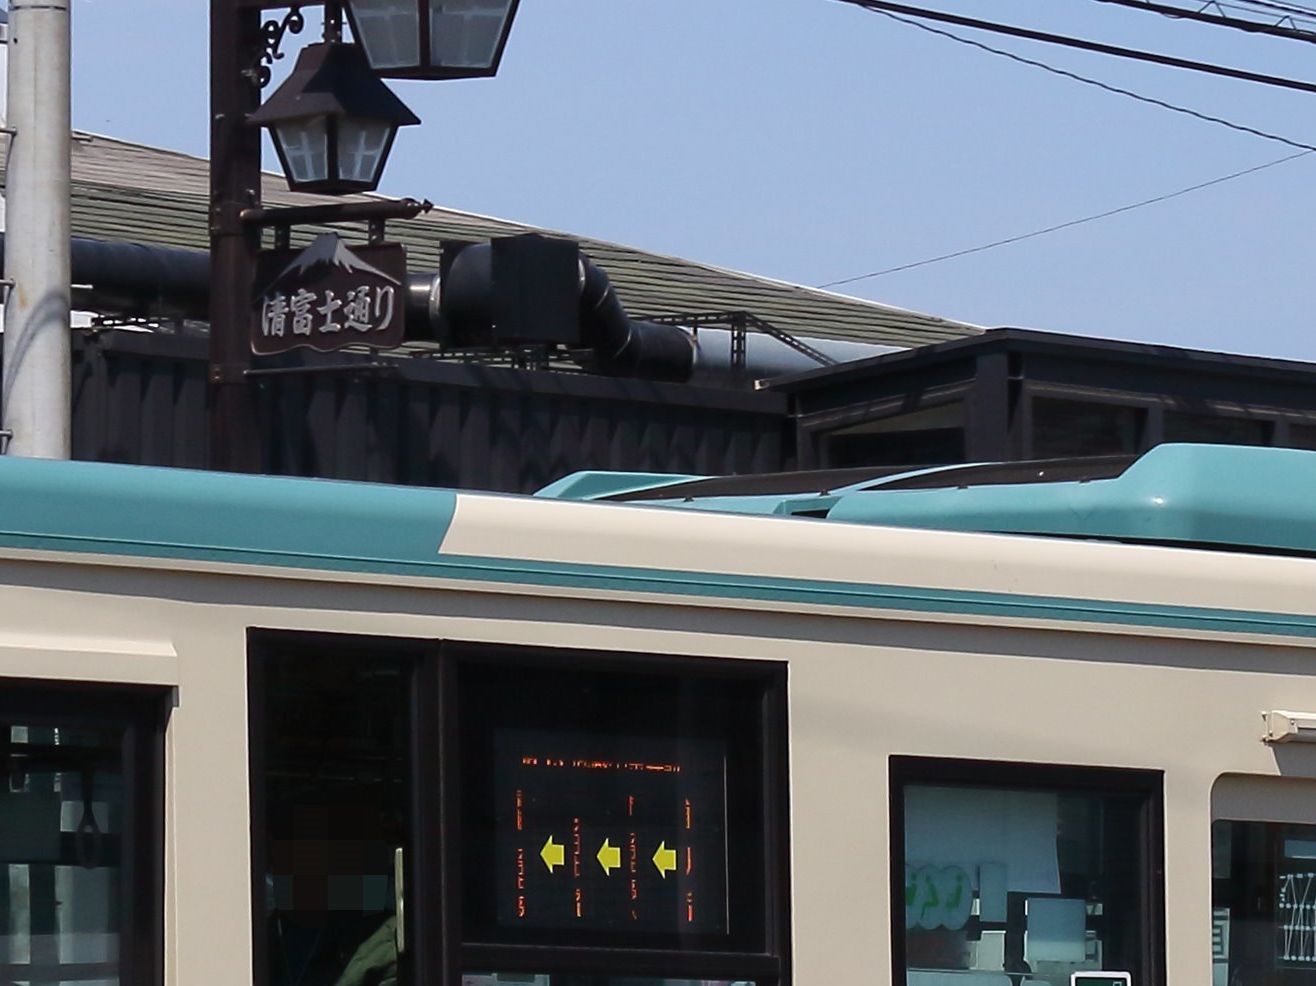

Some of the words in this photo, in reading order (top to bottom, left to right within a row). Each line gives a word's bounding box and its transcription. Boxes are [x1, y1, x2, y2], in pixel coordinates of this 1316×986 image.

[261, 286, 395, 337] 清富士通り
